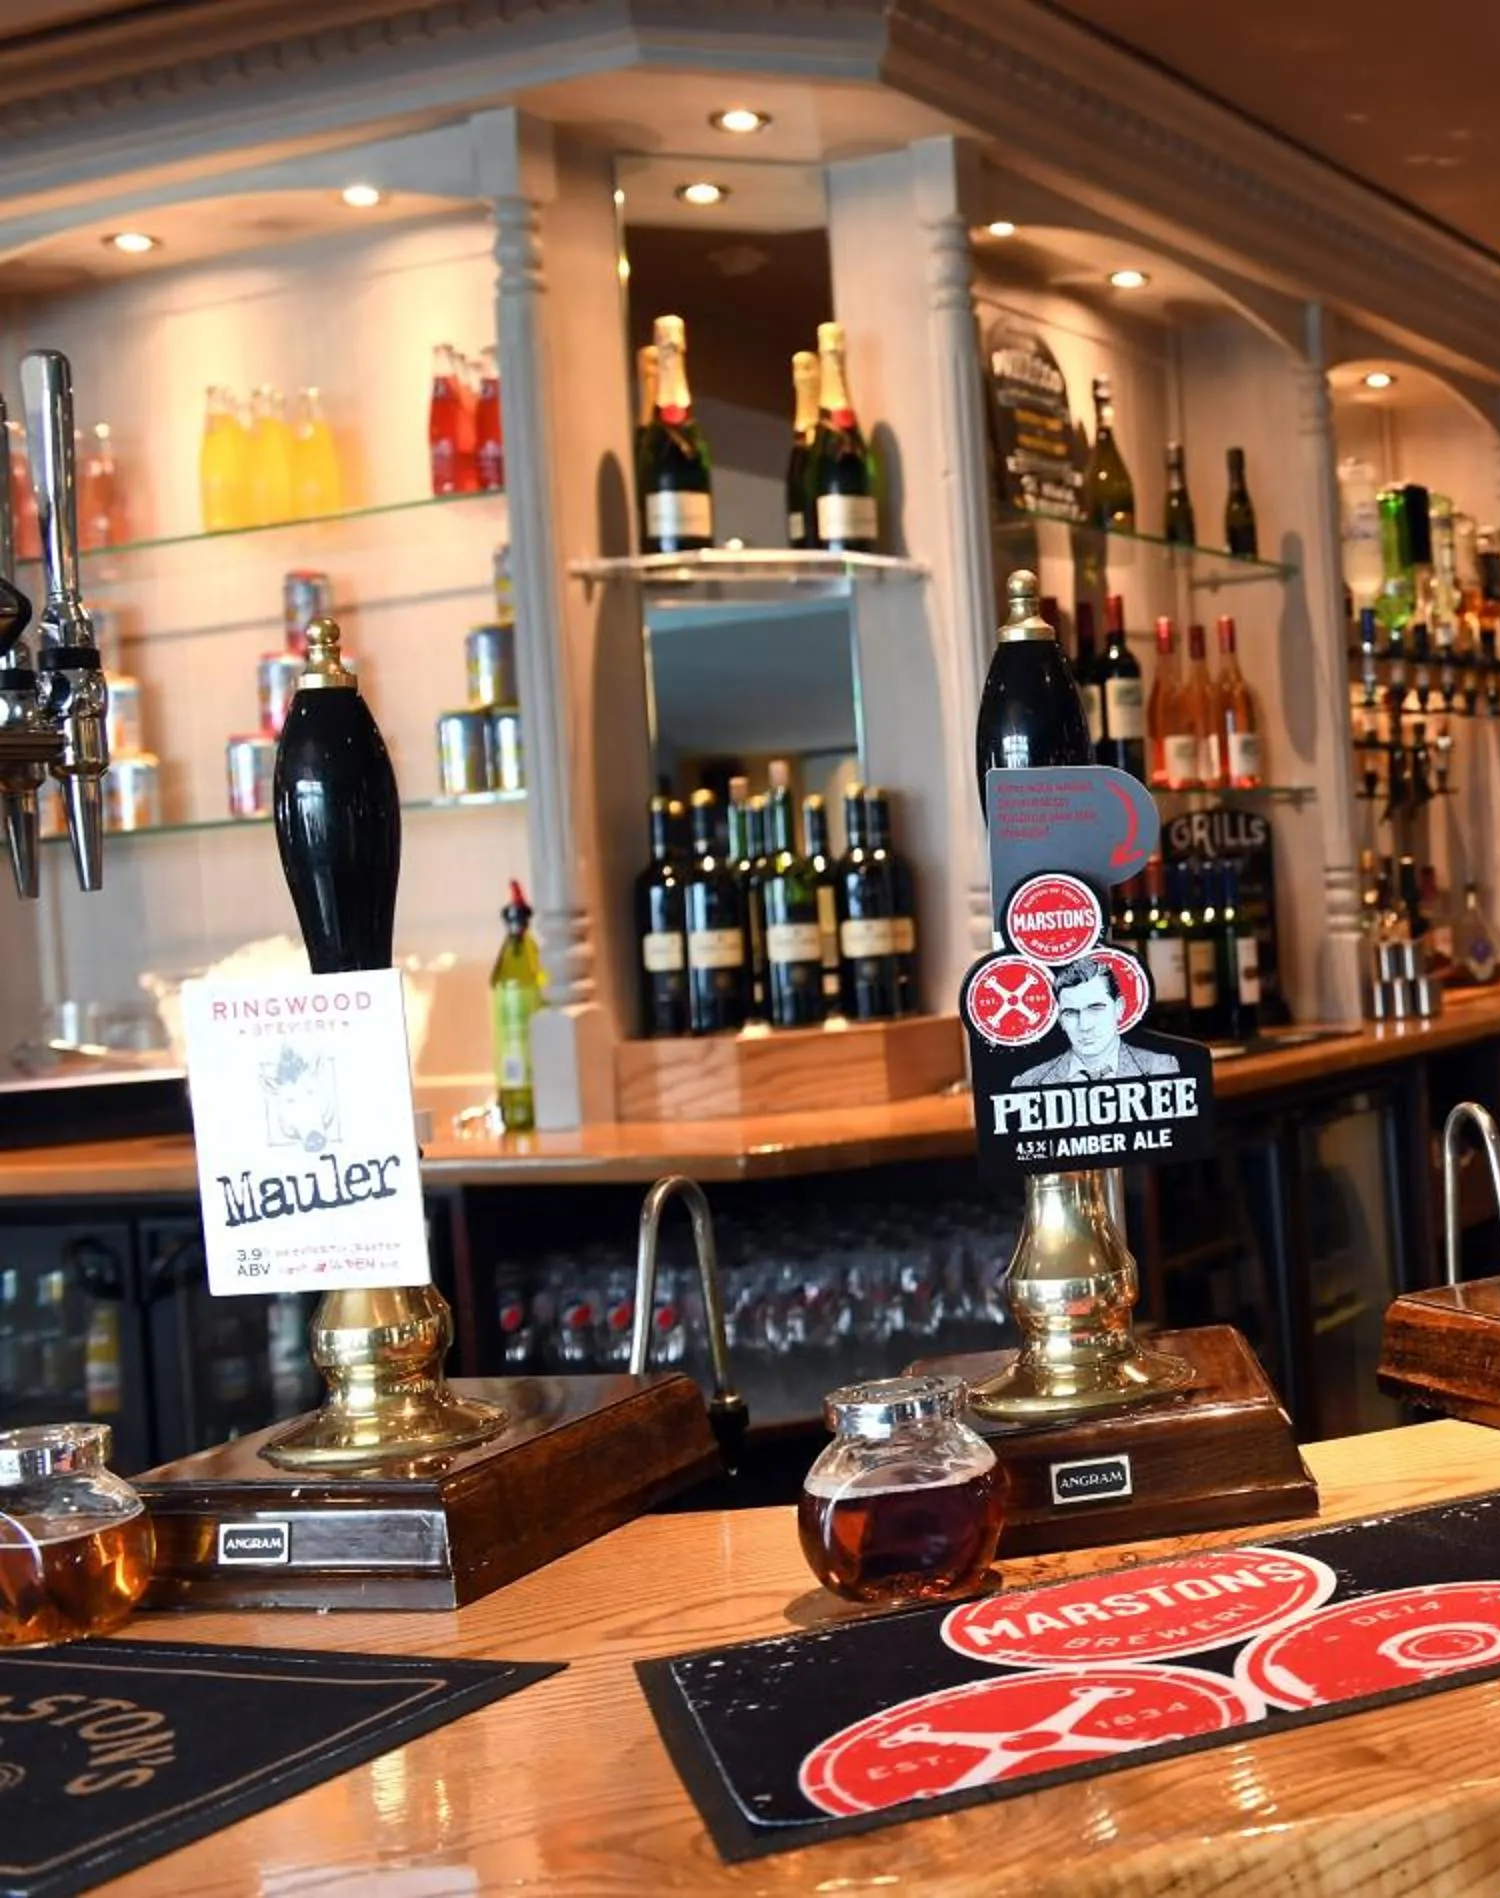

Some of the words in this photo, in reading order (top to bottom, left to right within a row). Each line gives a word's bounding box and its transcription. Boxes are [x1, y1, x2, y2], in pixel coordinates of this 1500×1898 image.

[1169, 812, 1266, 858] GRILLS
[211, 991, 372, 1021] RINGWOOD
[989, 1077, 1199, 1135] PEDIGREE
[1056, 1132, 1127, 1157] AMBER
[1133, 1128, 1173, 1150] ALE
[216, 1153, 401, 1228] Mauler
[236, 1263, 271, 1277] ABV
[1060, 1470, 1123, 1489] ANGRAM
[225, 1537, 282, 1550] ANGRAM
[963, 1560, 1307, 1647] MARSTON'S
[1350, 1600, 1444, 1628] DE14
[1062, 1603, 1258, 1649] BREWERY
[0, 1694, 177, 1795] STON'S
[866, 1754, 957, 1781] EST.
